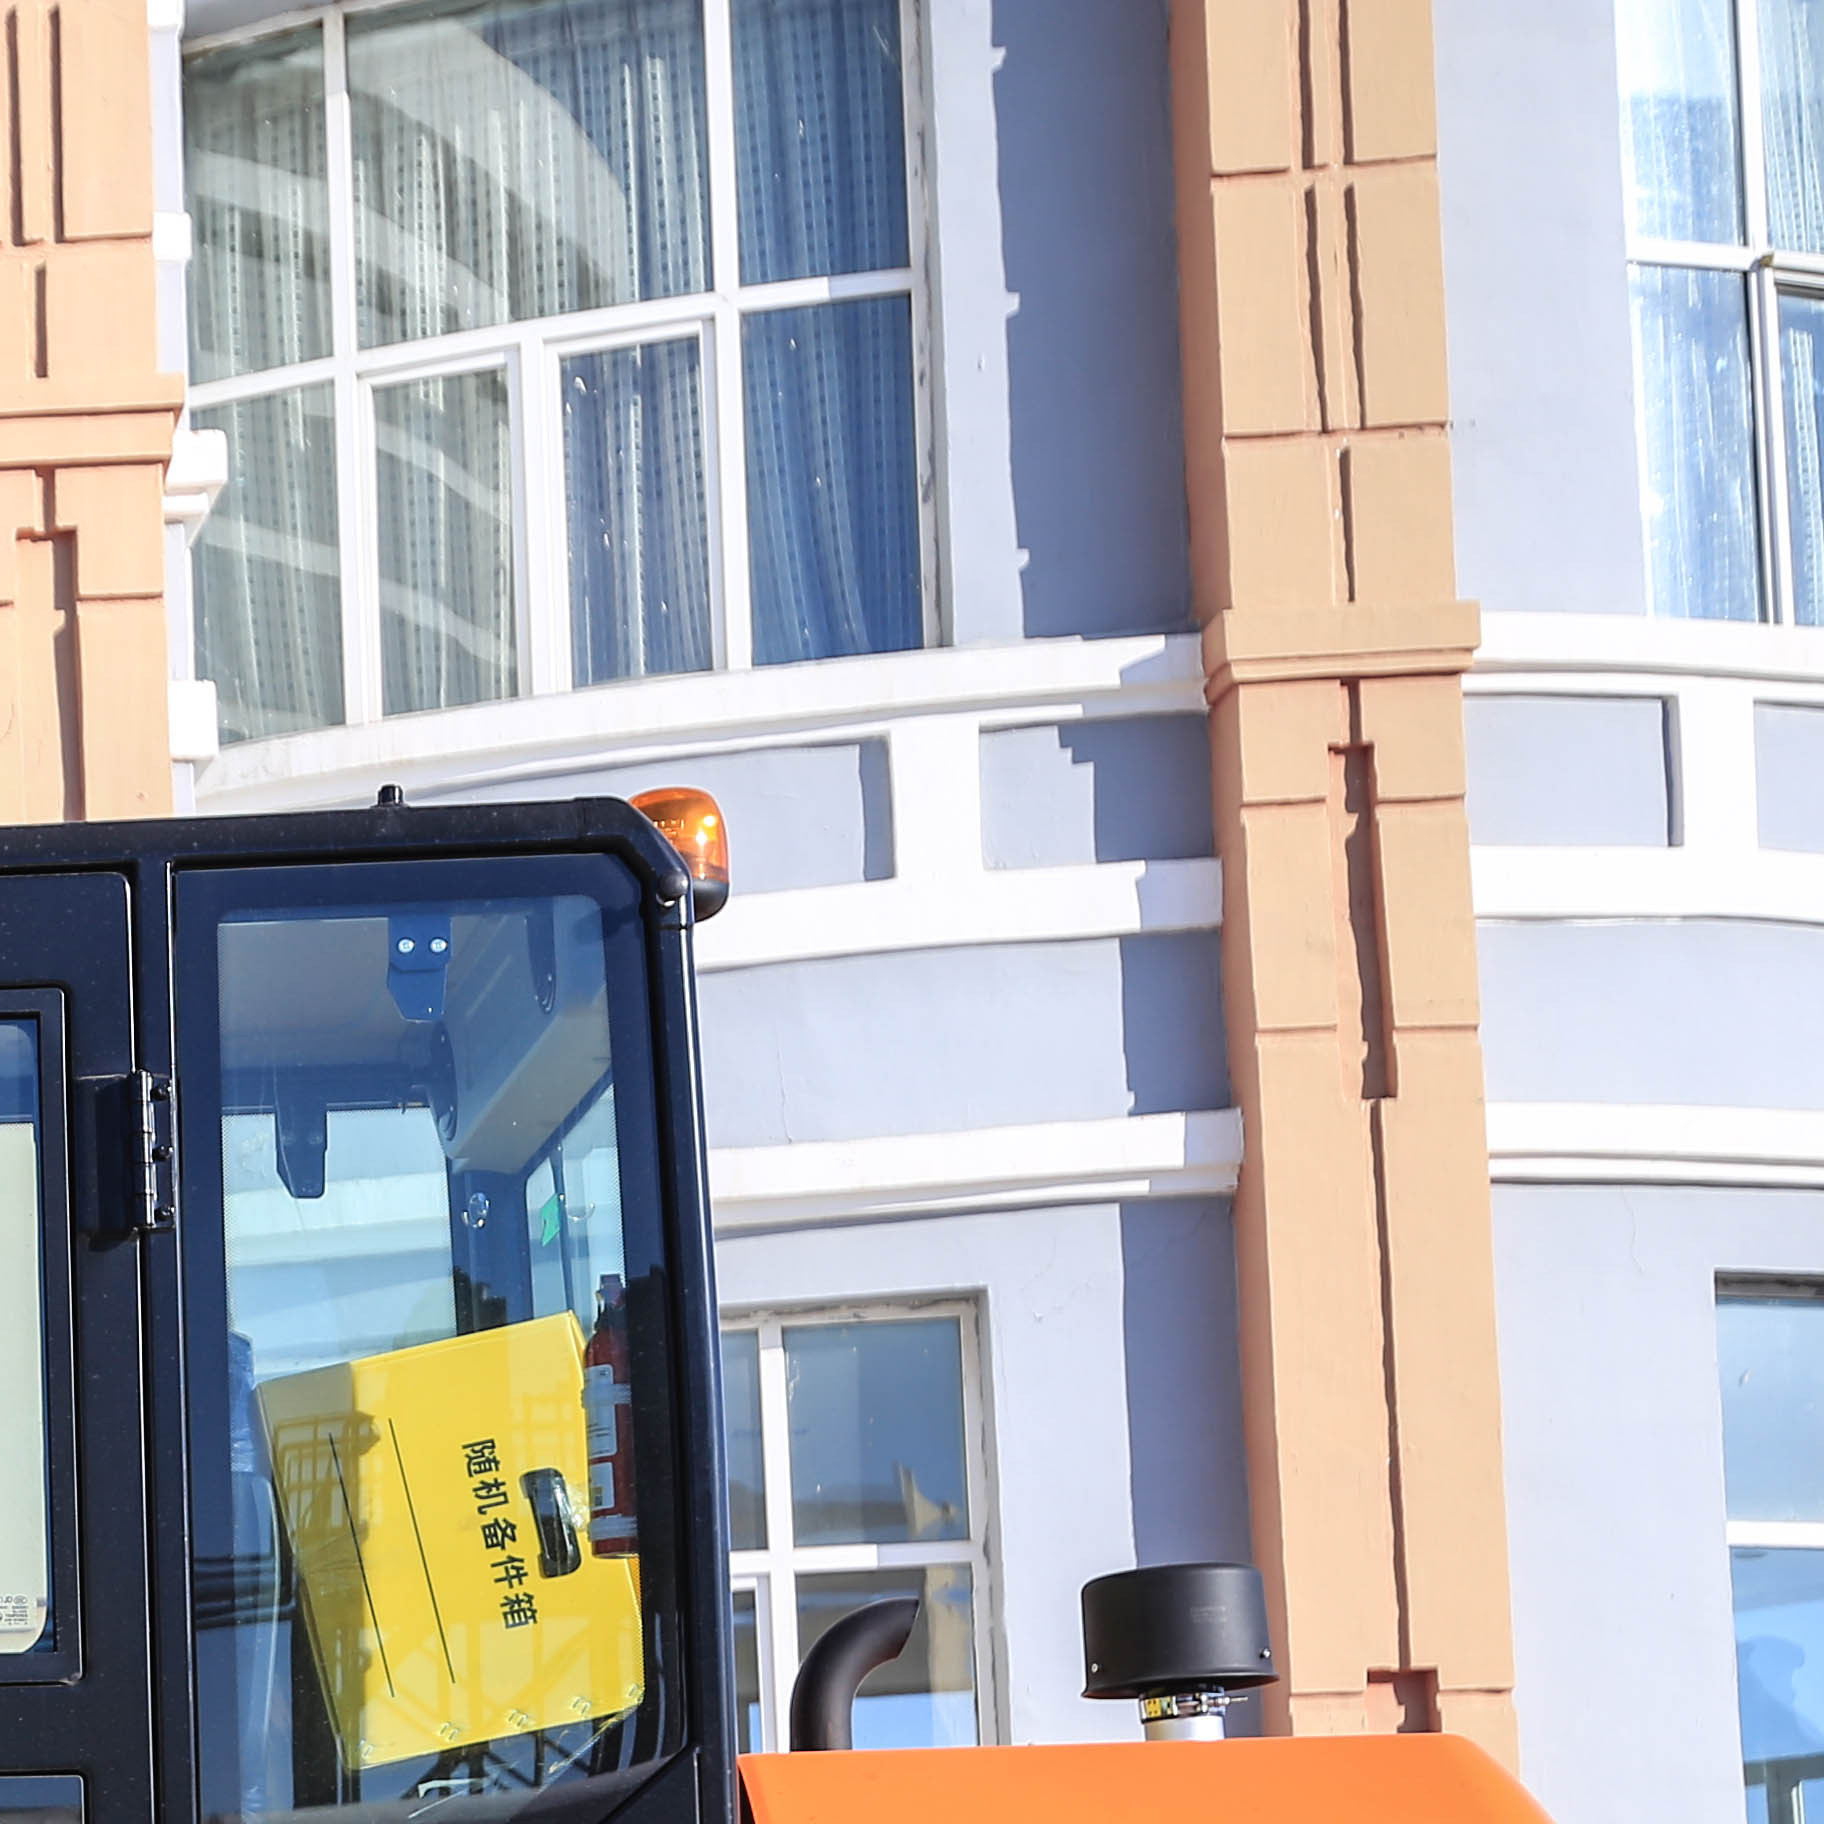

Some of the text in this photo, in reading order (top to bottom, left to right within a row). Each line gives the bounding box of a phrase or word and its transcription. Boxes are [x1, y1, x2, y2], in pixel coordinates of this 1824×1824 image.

[461, 1438, 539, 1630] 随机备件箱
